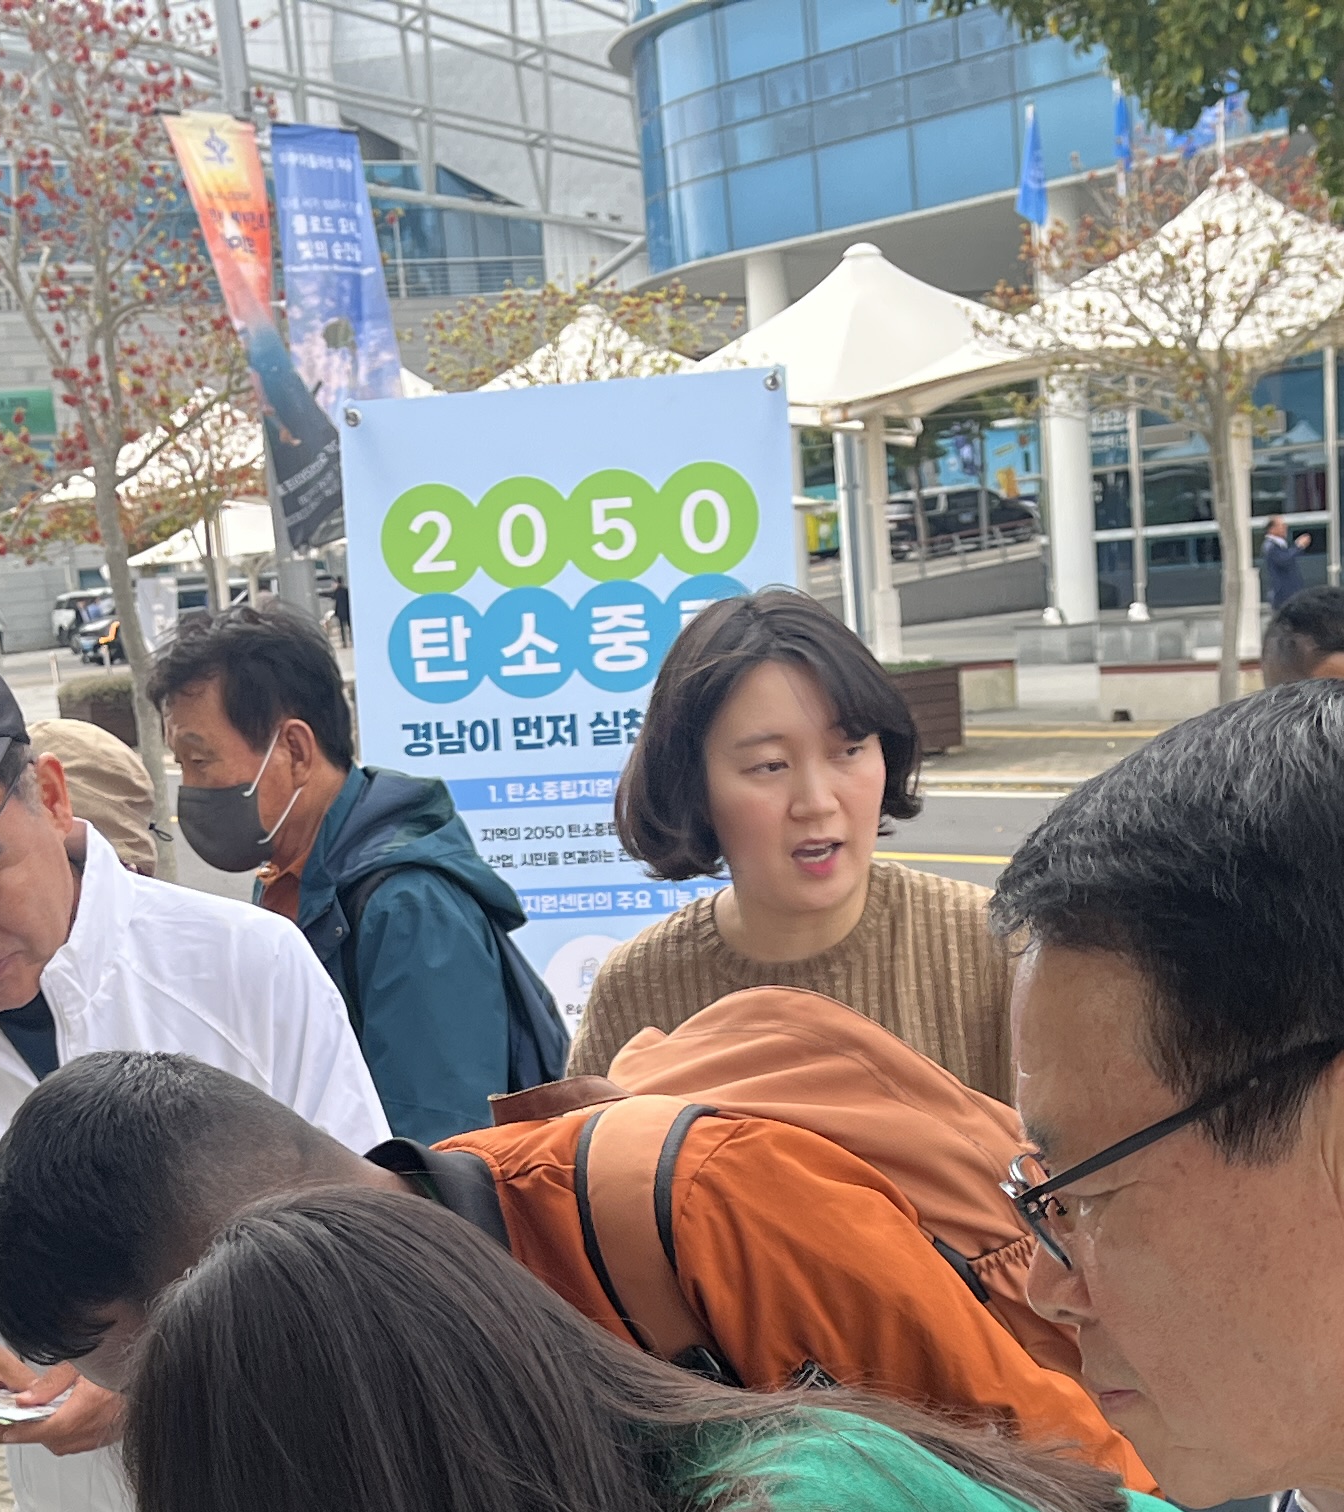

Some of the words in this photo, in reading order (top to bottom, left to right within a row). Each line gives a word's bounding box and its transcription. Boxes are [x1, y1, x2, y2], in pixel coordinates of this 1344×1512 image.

[409, 489, 732, 574] 2050
[408, 600, 712, 684] 탄소중
[402, 718, 502, 757] 경남이
[513, 713, 579, 750] 먼저
[487, 784, 503, 803] 1.
[506, 778, 619, 803] 탄소중립지원
[481, 826, 521, 842] 지역의
[523, 825, 565, 840] 2050
[523, 890, 613, 914] 지원센터의
[616, 889, 653, 910] 주요
